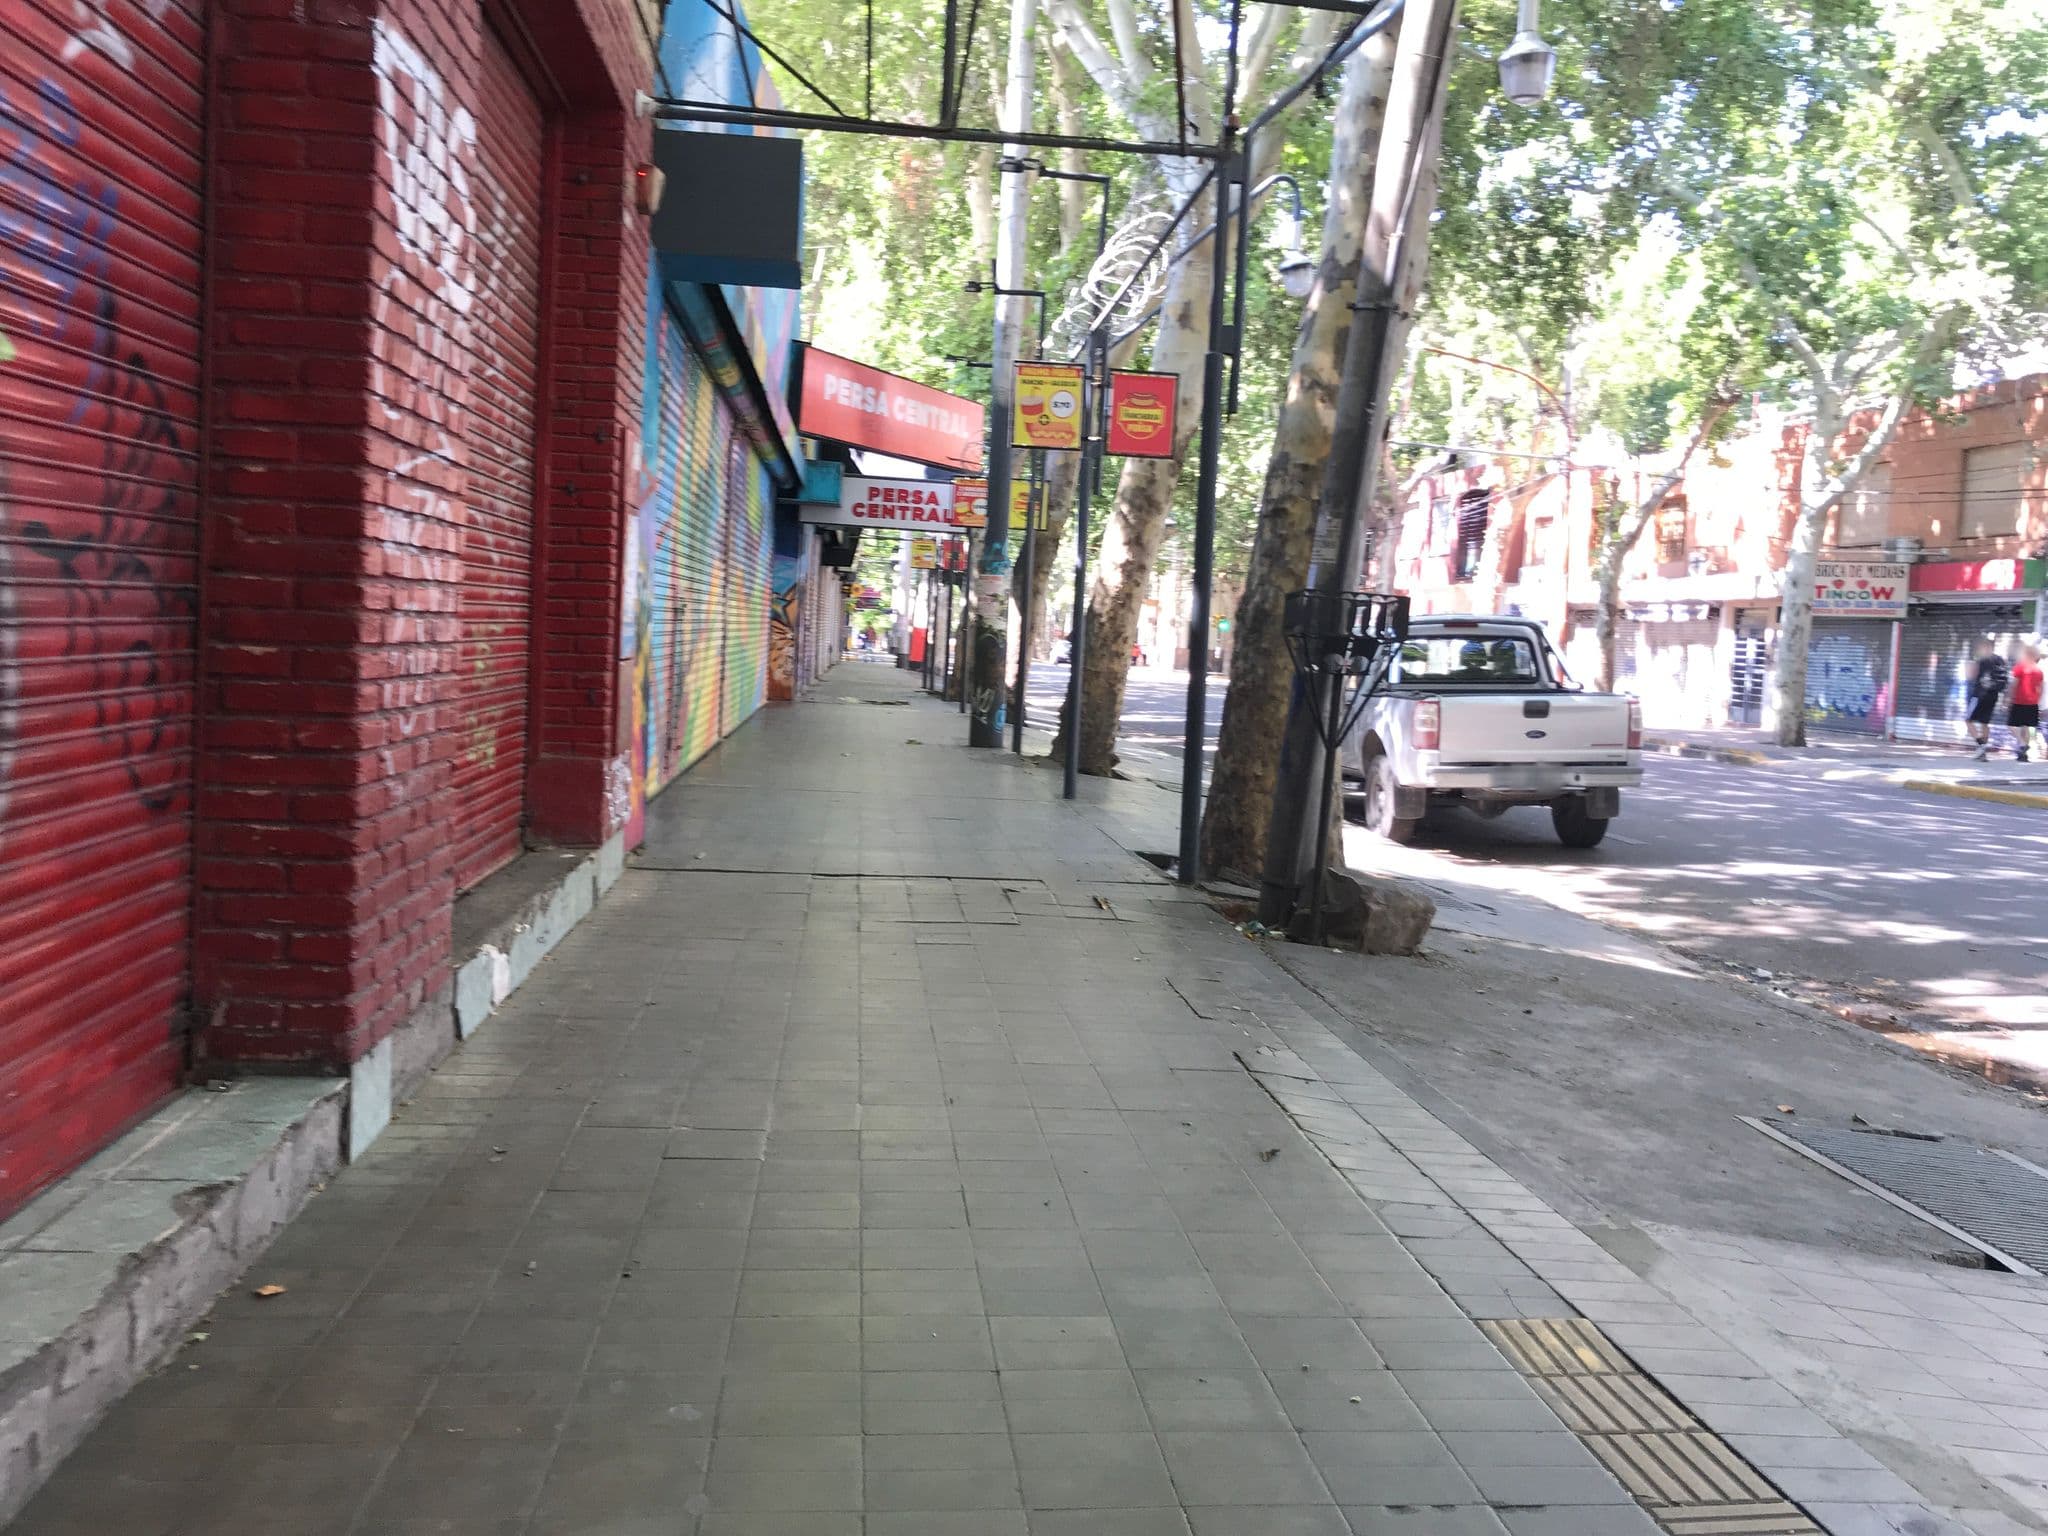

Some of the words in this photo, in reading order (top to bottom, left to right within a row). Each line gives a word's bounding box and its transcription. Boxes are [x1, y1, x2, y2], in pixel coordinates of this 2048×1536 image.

[824, 373, 888, 416] PERSA
[892, 396, 969, 439] CENTRAL
[868, 486, 940, 506] PERSA
[852, 503, 954, 523] CENTRAL
[1849, 565, 1862, 577] DE
[1815, 585, 1894, 599] TINCOW
